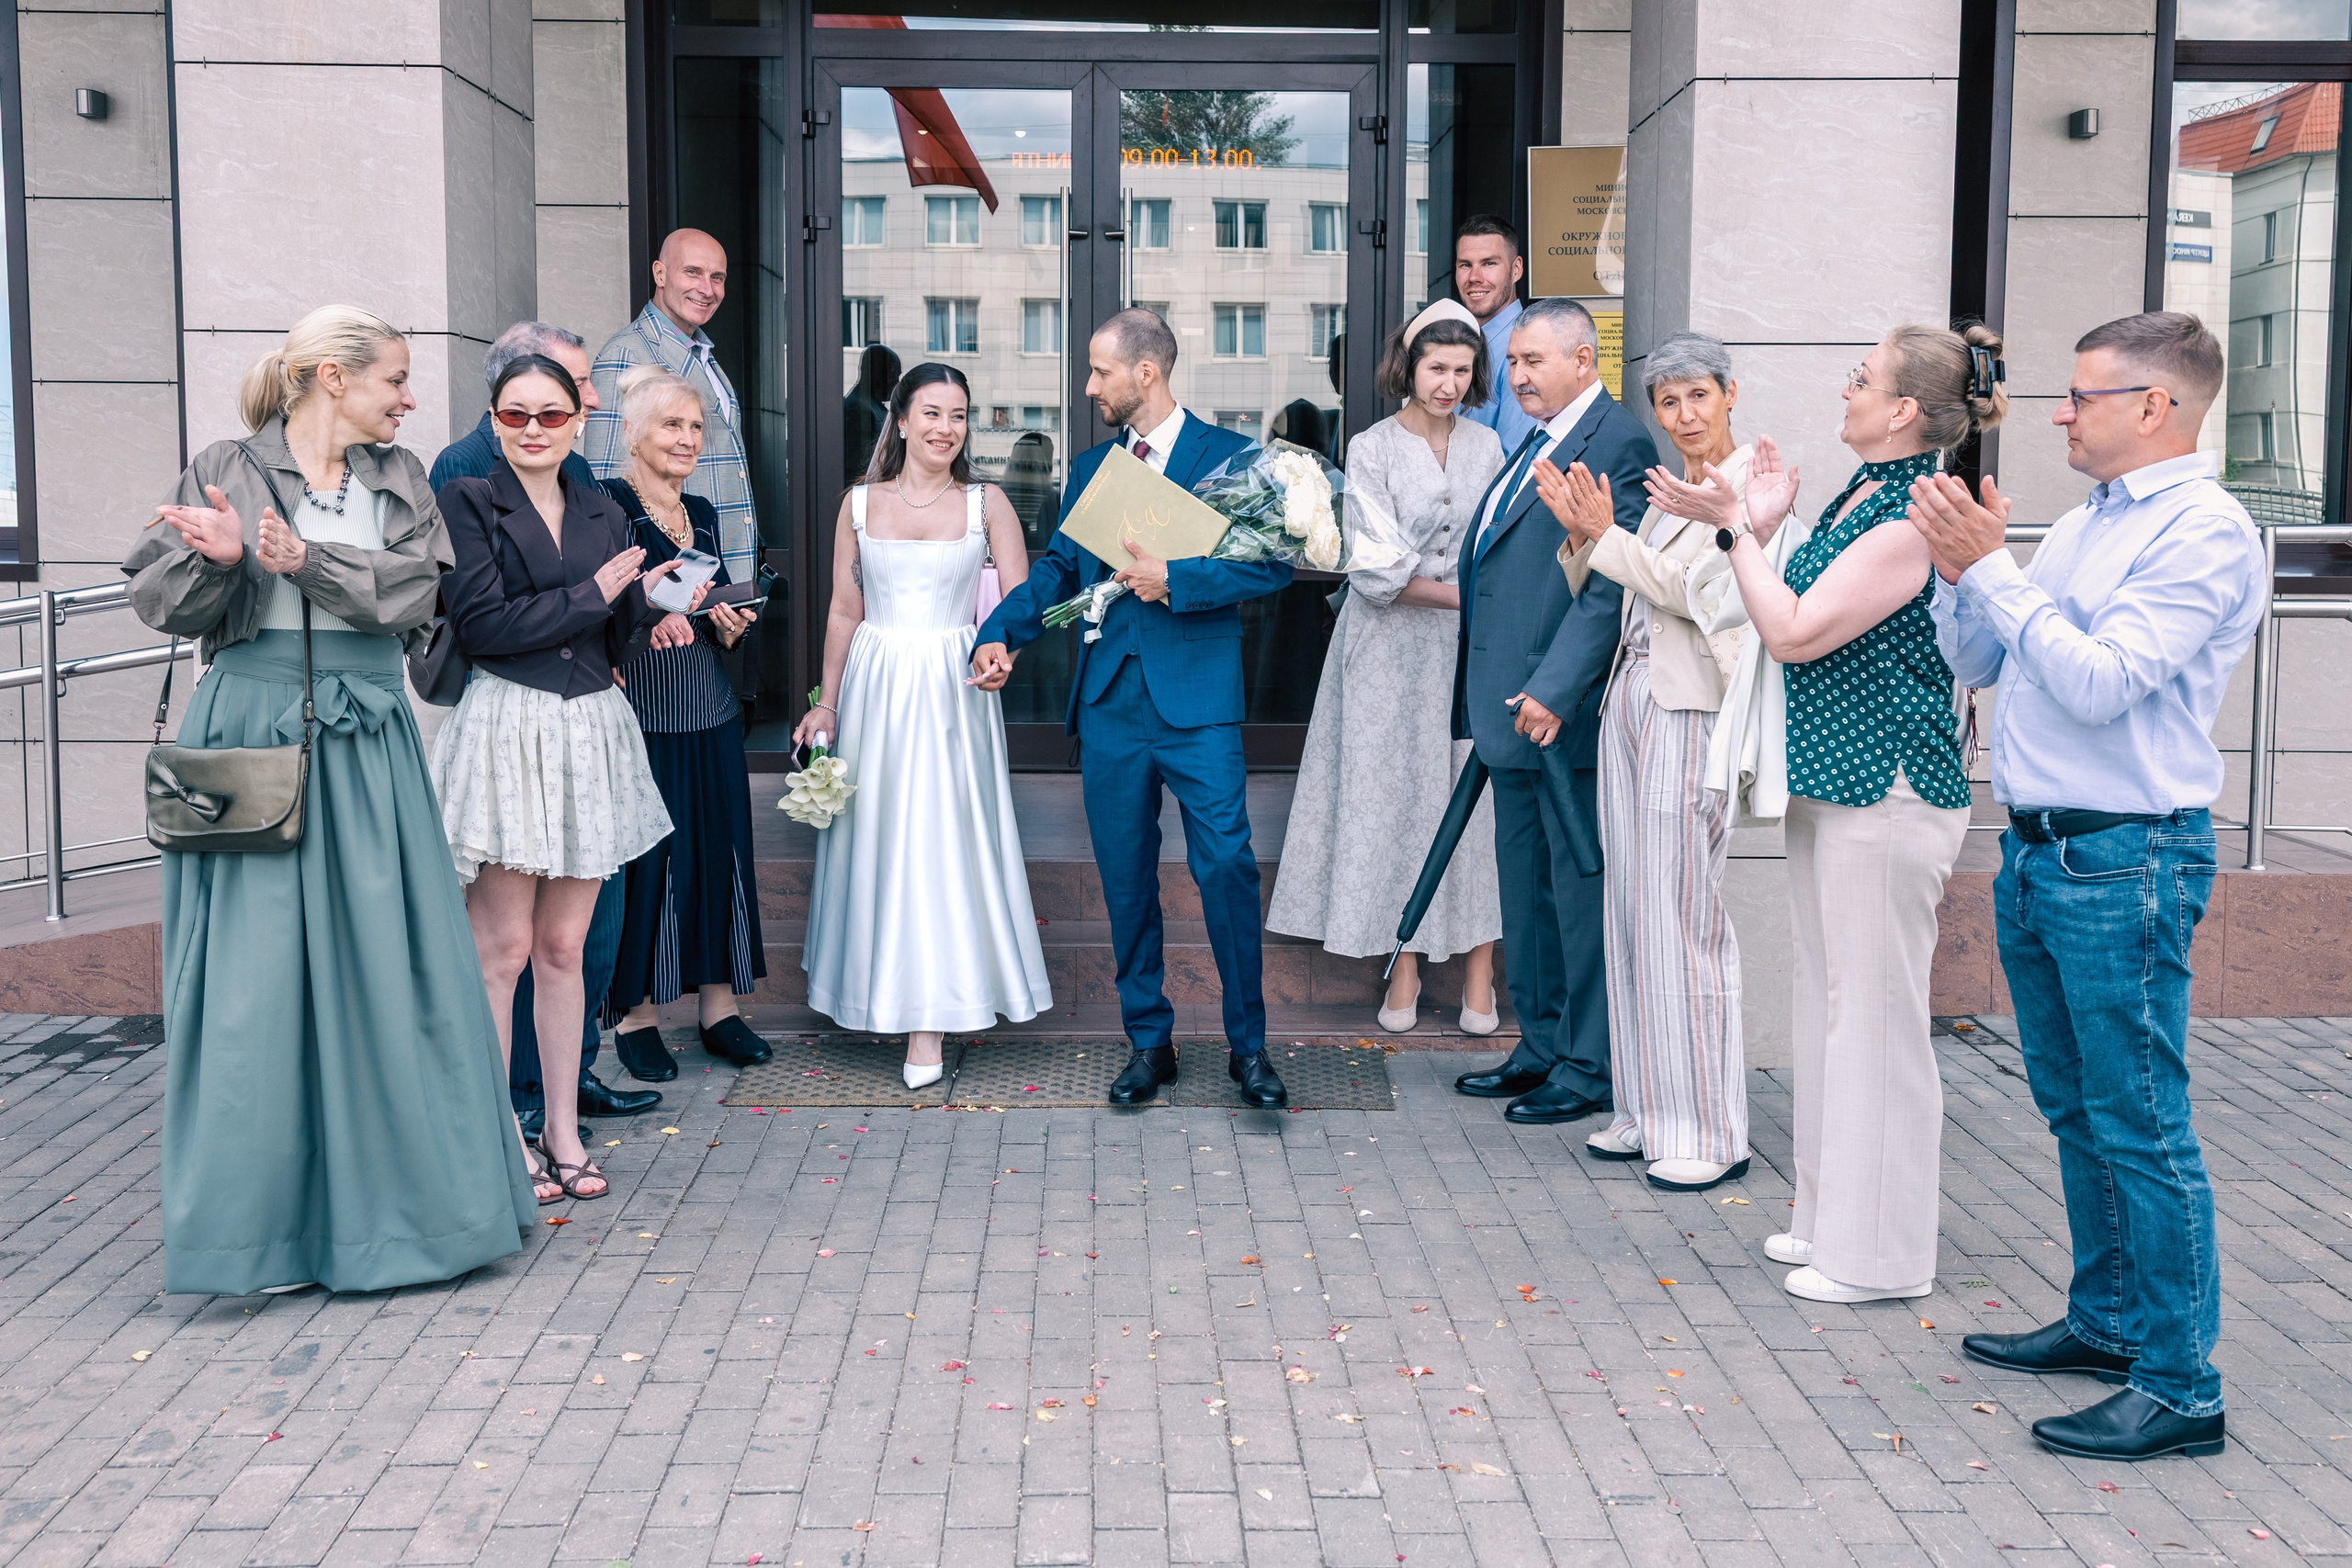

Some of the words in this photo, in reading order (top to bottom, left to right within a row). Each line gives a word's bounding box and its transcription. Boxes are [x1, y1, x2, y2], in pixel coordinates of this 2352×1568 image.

[1572, 196, 1627, 205] СОЦИАЛЬН
[1547, 246, 1626, 256] СОЦИАЛЬНО
[1592, 270, 1625, 281] ОТД
